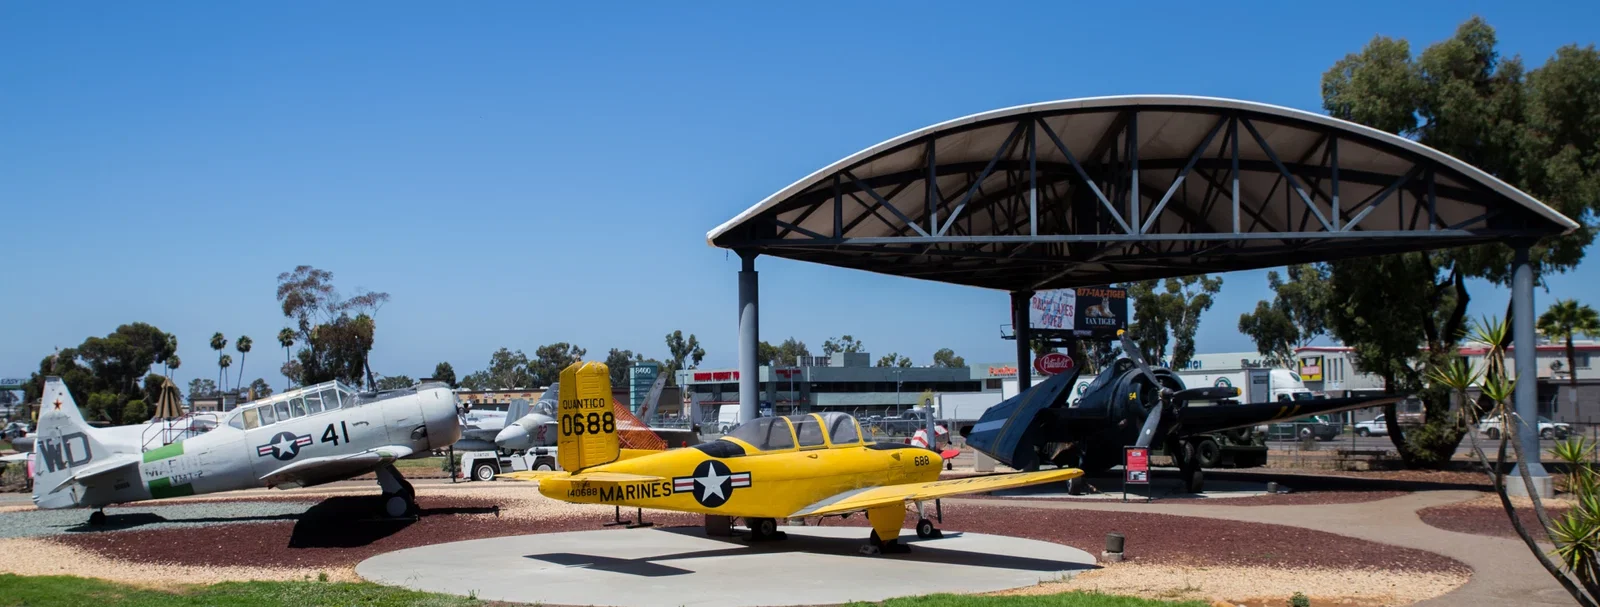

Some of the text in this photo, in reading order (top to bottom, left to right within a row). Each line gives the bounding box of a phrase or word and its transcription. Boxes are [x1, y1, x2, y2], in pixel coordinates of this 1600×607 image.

[1077, 288, 1125, 299] 877-TAX-TIGER
[1085, 317, 1116, 325] TAX TIGER
[563, 398, 605, 409] QUANTICO
[562, 411, 614, 436] 0688
[321, 420, 350, 446] 41
[38, 431, 92, 473] WD
[914, 455, 930, 467] 688
[567, 487, 598, 498] 140688
[600, 482, 671, 502] MARINES
